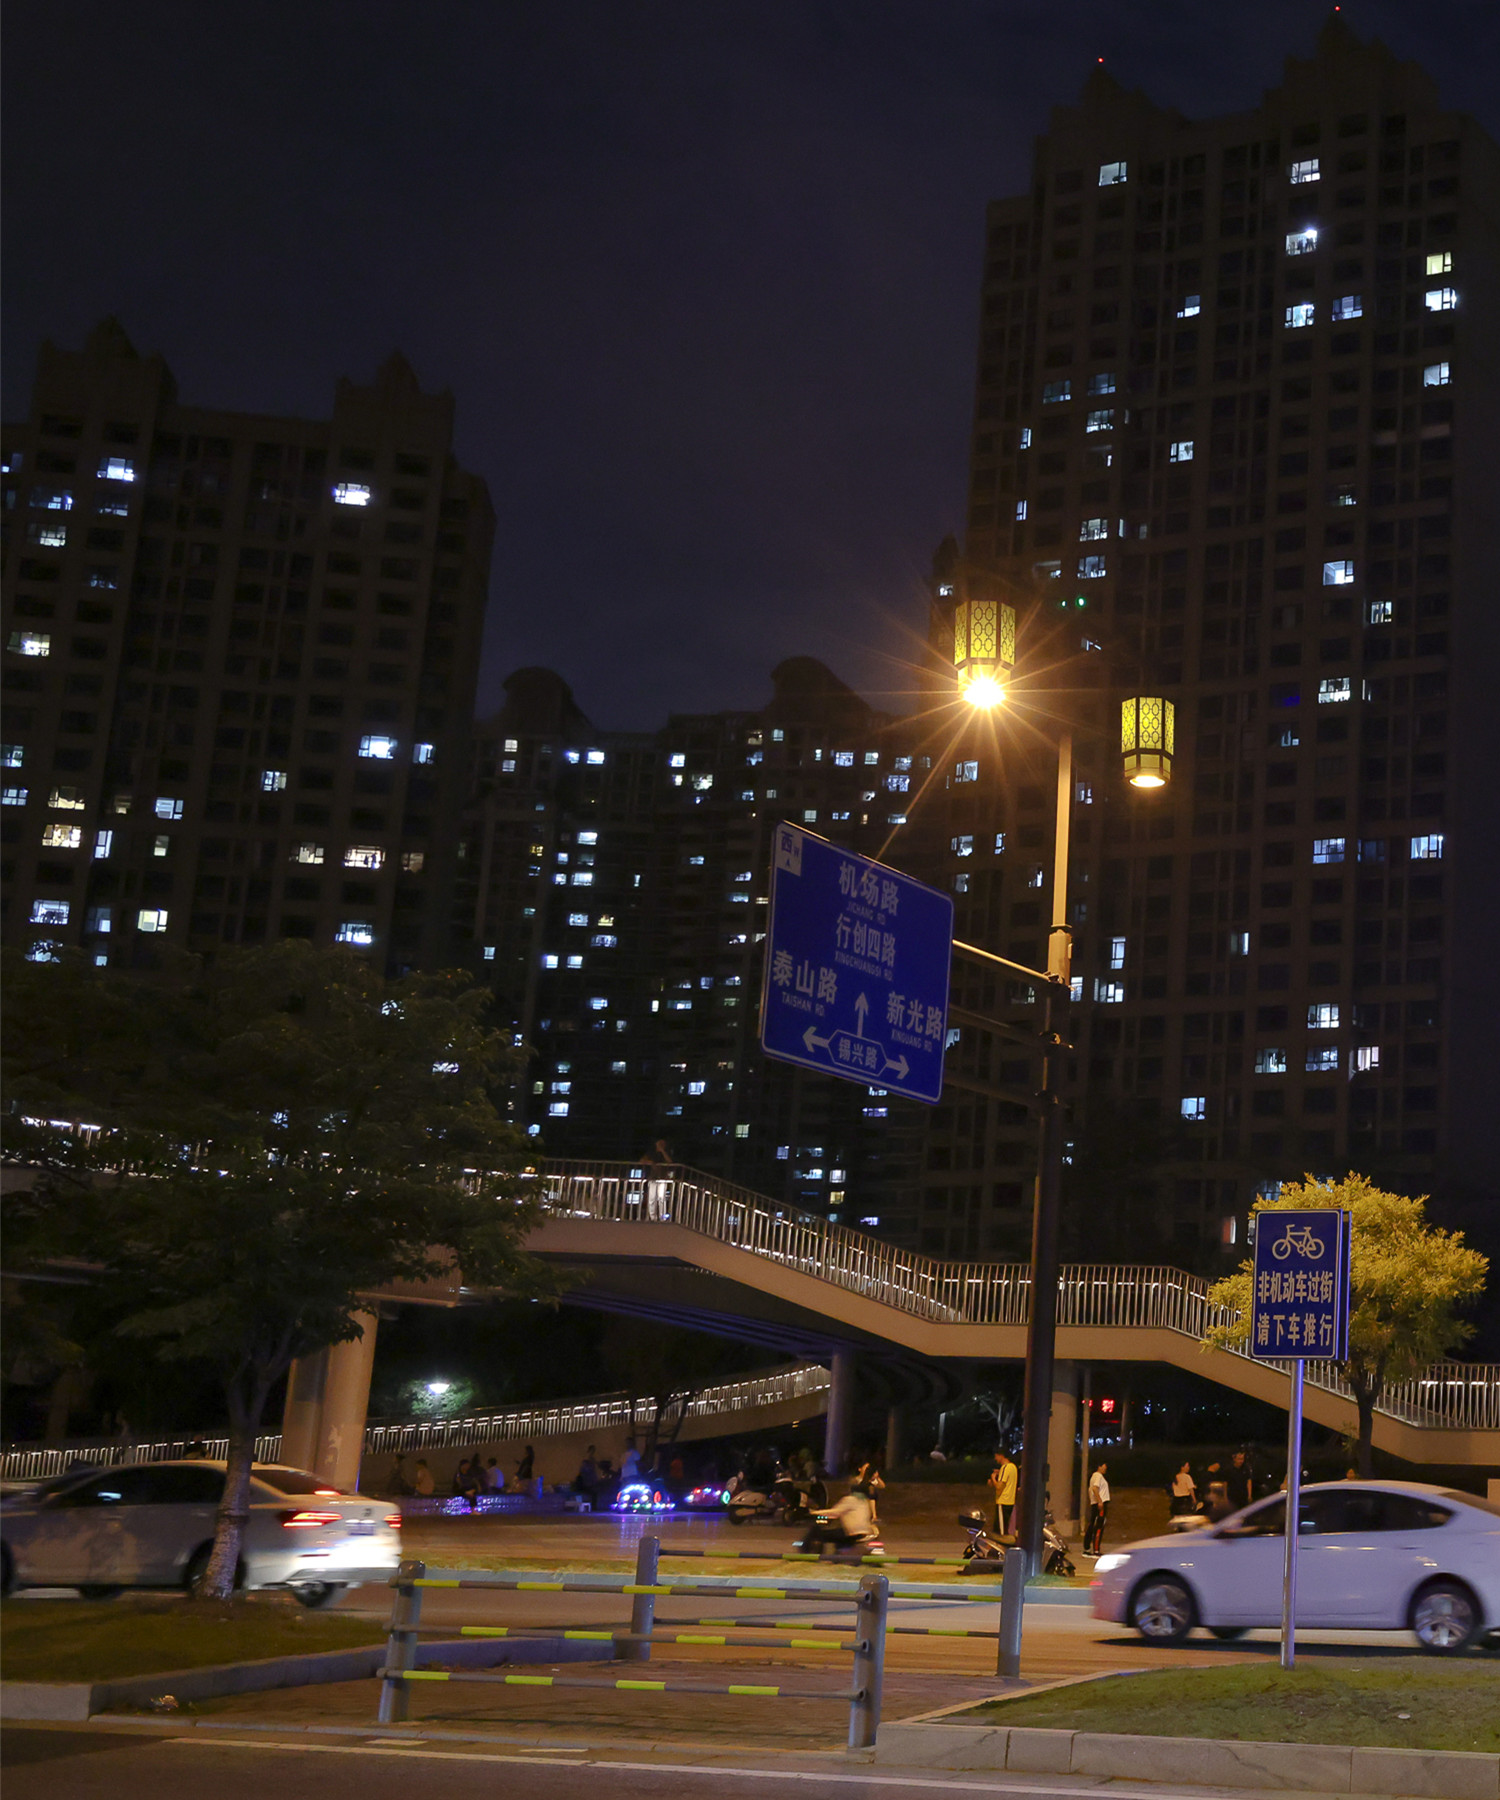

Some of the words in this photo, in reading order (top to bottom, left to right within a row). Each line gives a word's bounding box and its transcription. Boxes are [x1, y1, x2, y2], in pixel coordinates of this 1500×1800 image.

[781, 830, 794, 854] 西
[839, 860, 899, 916] 机场路
[846, 901, 874, 920] JICHANG
[836, 913, 896, 968] 行创四路
[773, 950, 838, 1004] 泰山路
[834, 950, 882, 977] XINGCHUANGSI
[782, 991, 812, 1012] TAISHAN
[886, 990, 943, 1041] 新光路
[839, 1037, 877, 1070] 锡兴路
[891, 1028, 922, 1049] XINGUANG
[1257, 1270, 1333, 1304] 非机动车过街
[1257, 1312, 1333, 1347] 请下车推行
